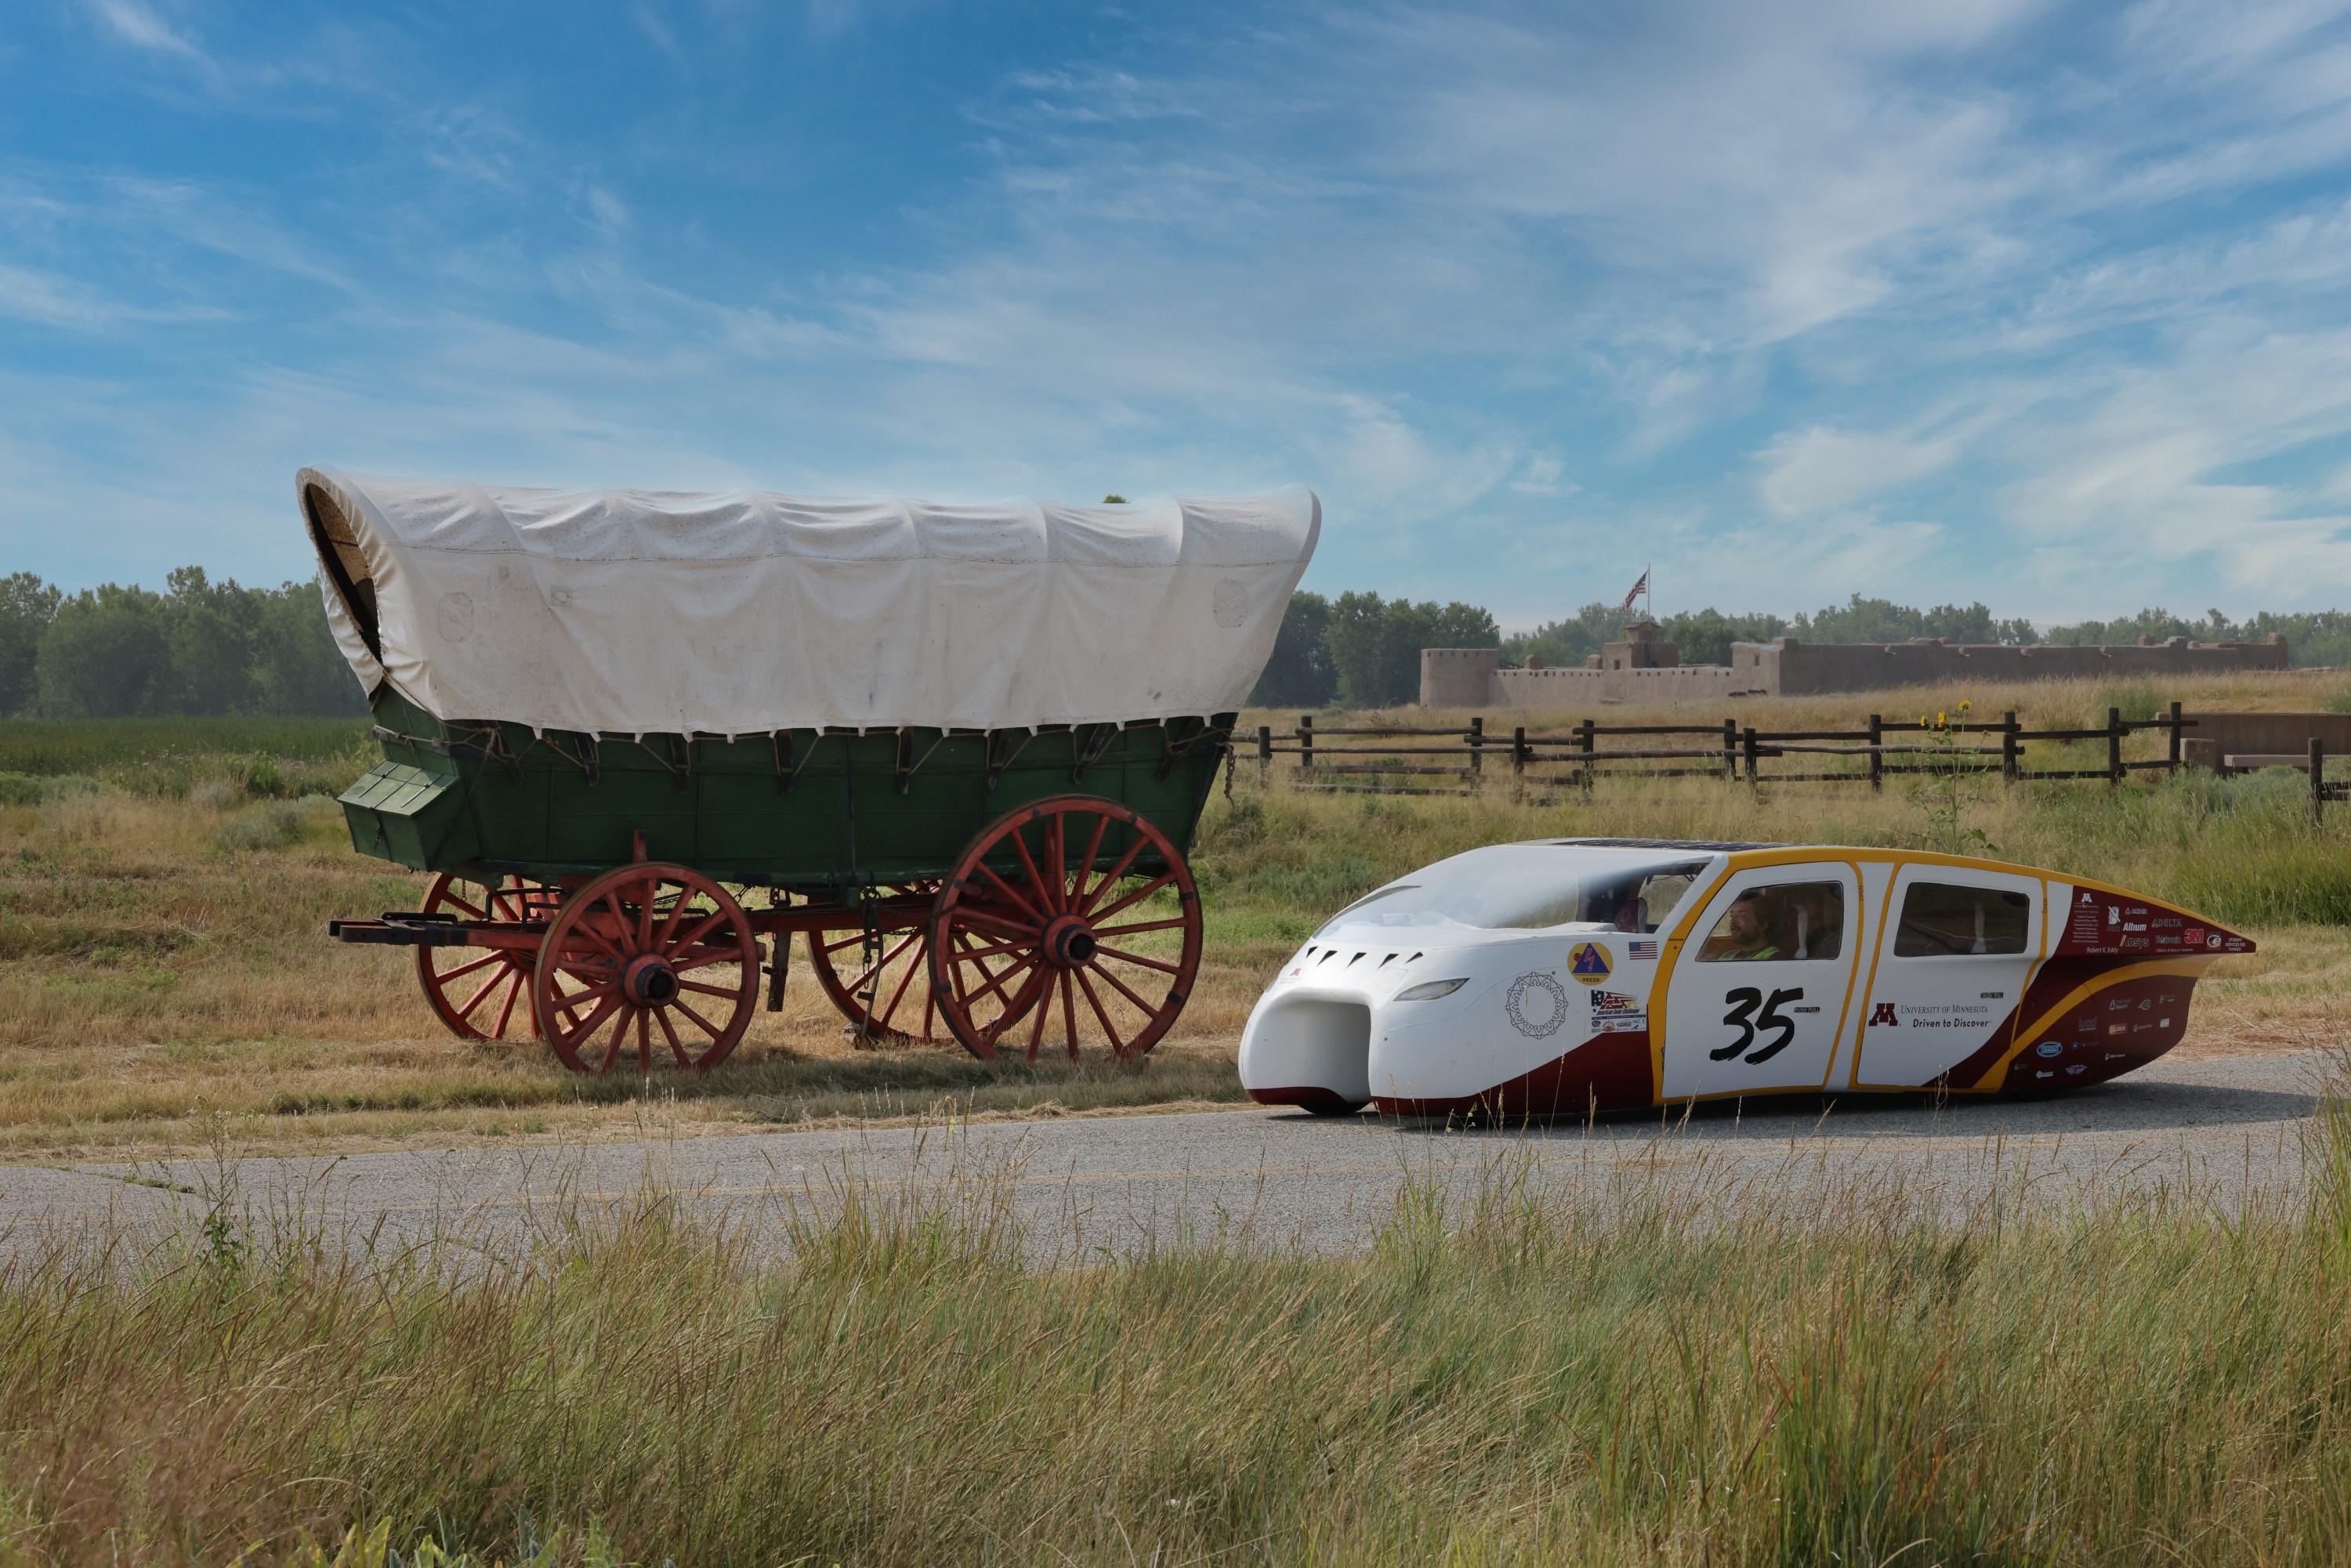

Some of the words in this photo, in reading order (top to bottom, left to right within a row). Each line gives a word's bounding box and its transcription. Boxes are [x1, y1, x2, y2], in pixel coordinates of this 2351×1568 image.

[2122, 922, 2147, 932] Altium
[2119, 935, 2149, 949] Ansys
[2184, 928, 2204, 944] 3M
[1868, 1003, 1898, 1027] M
[1709, 987, 1804, 1066] 35
[1913, 1018, 1940, 1028] Driven
[1943, 1019, 1951, 1028] to
[1954, 1018, 1989, 1028] Discover
